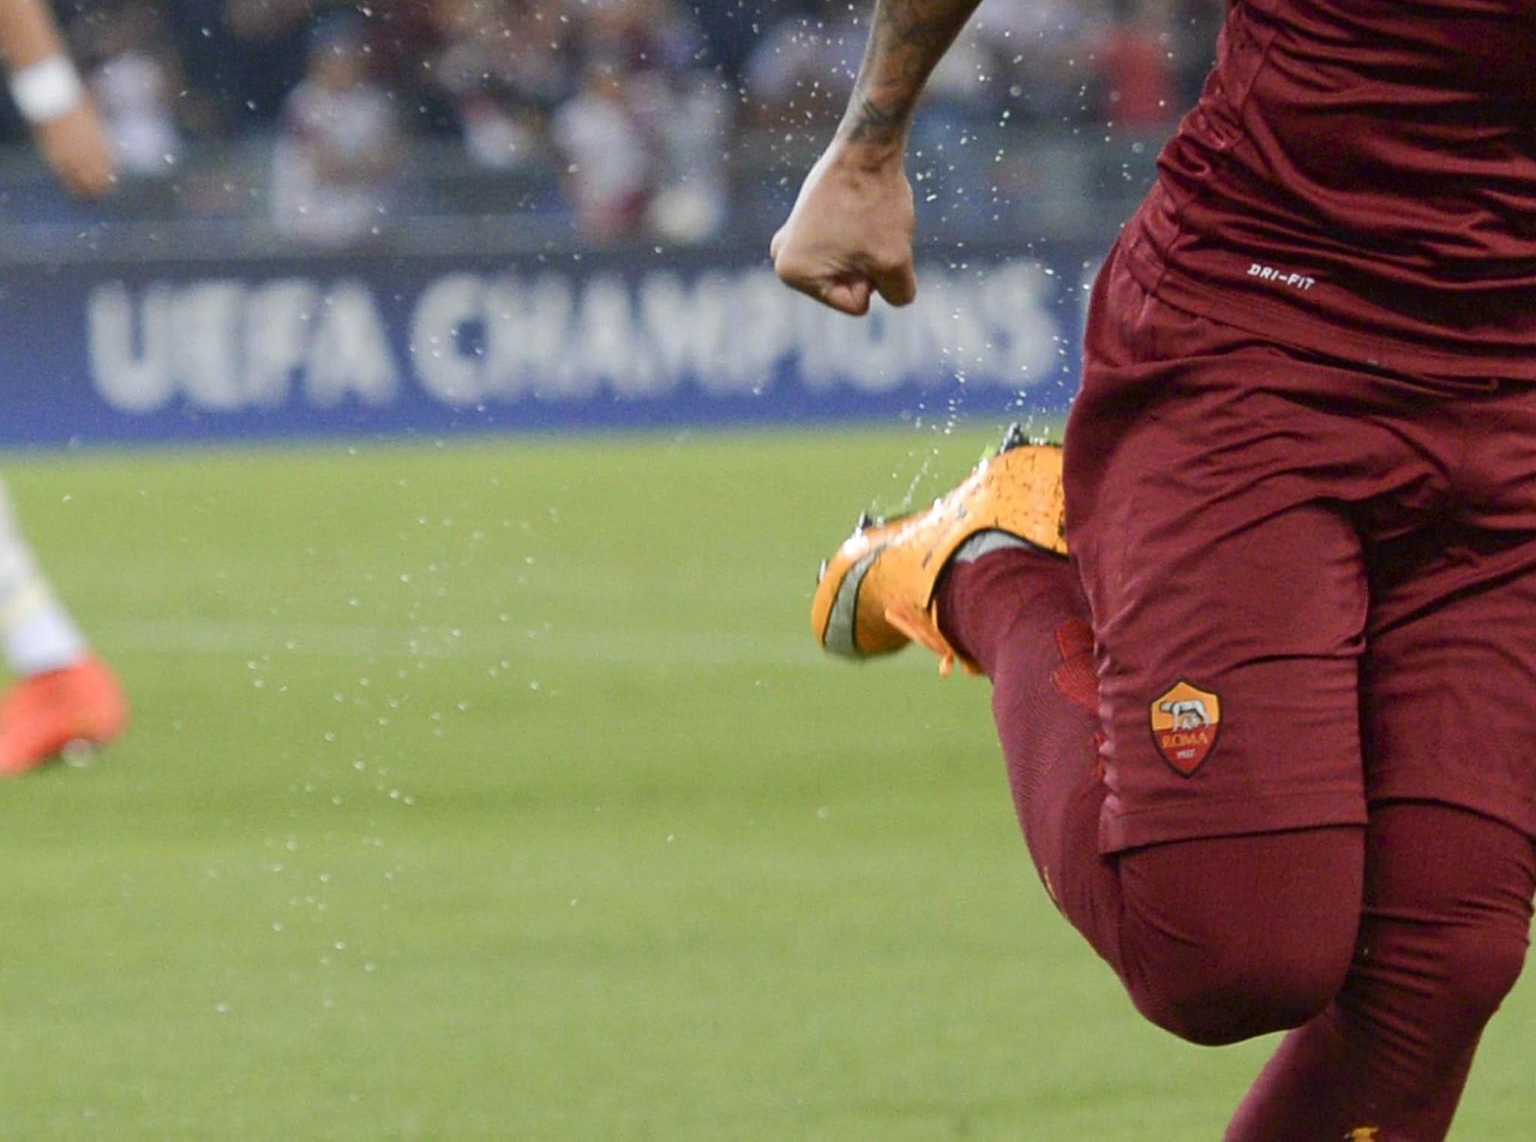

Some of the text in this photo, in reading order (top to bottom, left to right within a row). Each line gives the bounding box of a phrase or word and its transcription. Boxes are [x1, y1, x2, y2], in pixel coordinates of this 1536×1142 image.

[1247, 263, 1315, 290] DRI-FIT
[89, 263, 1060, 410] UEFA CHAMPIONS
[1162, 731, 1208, 747] ROMA
